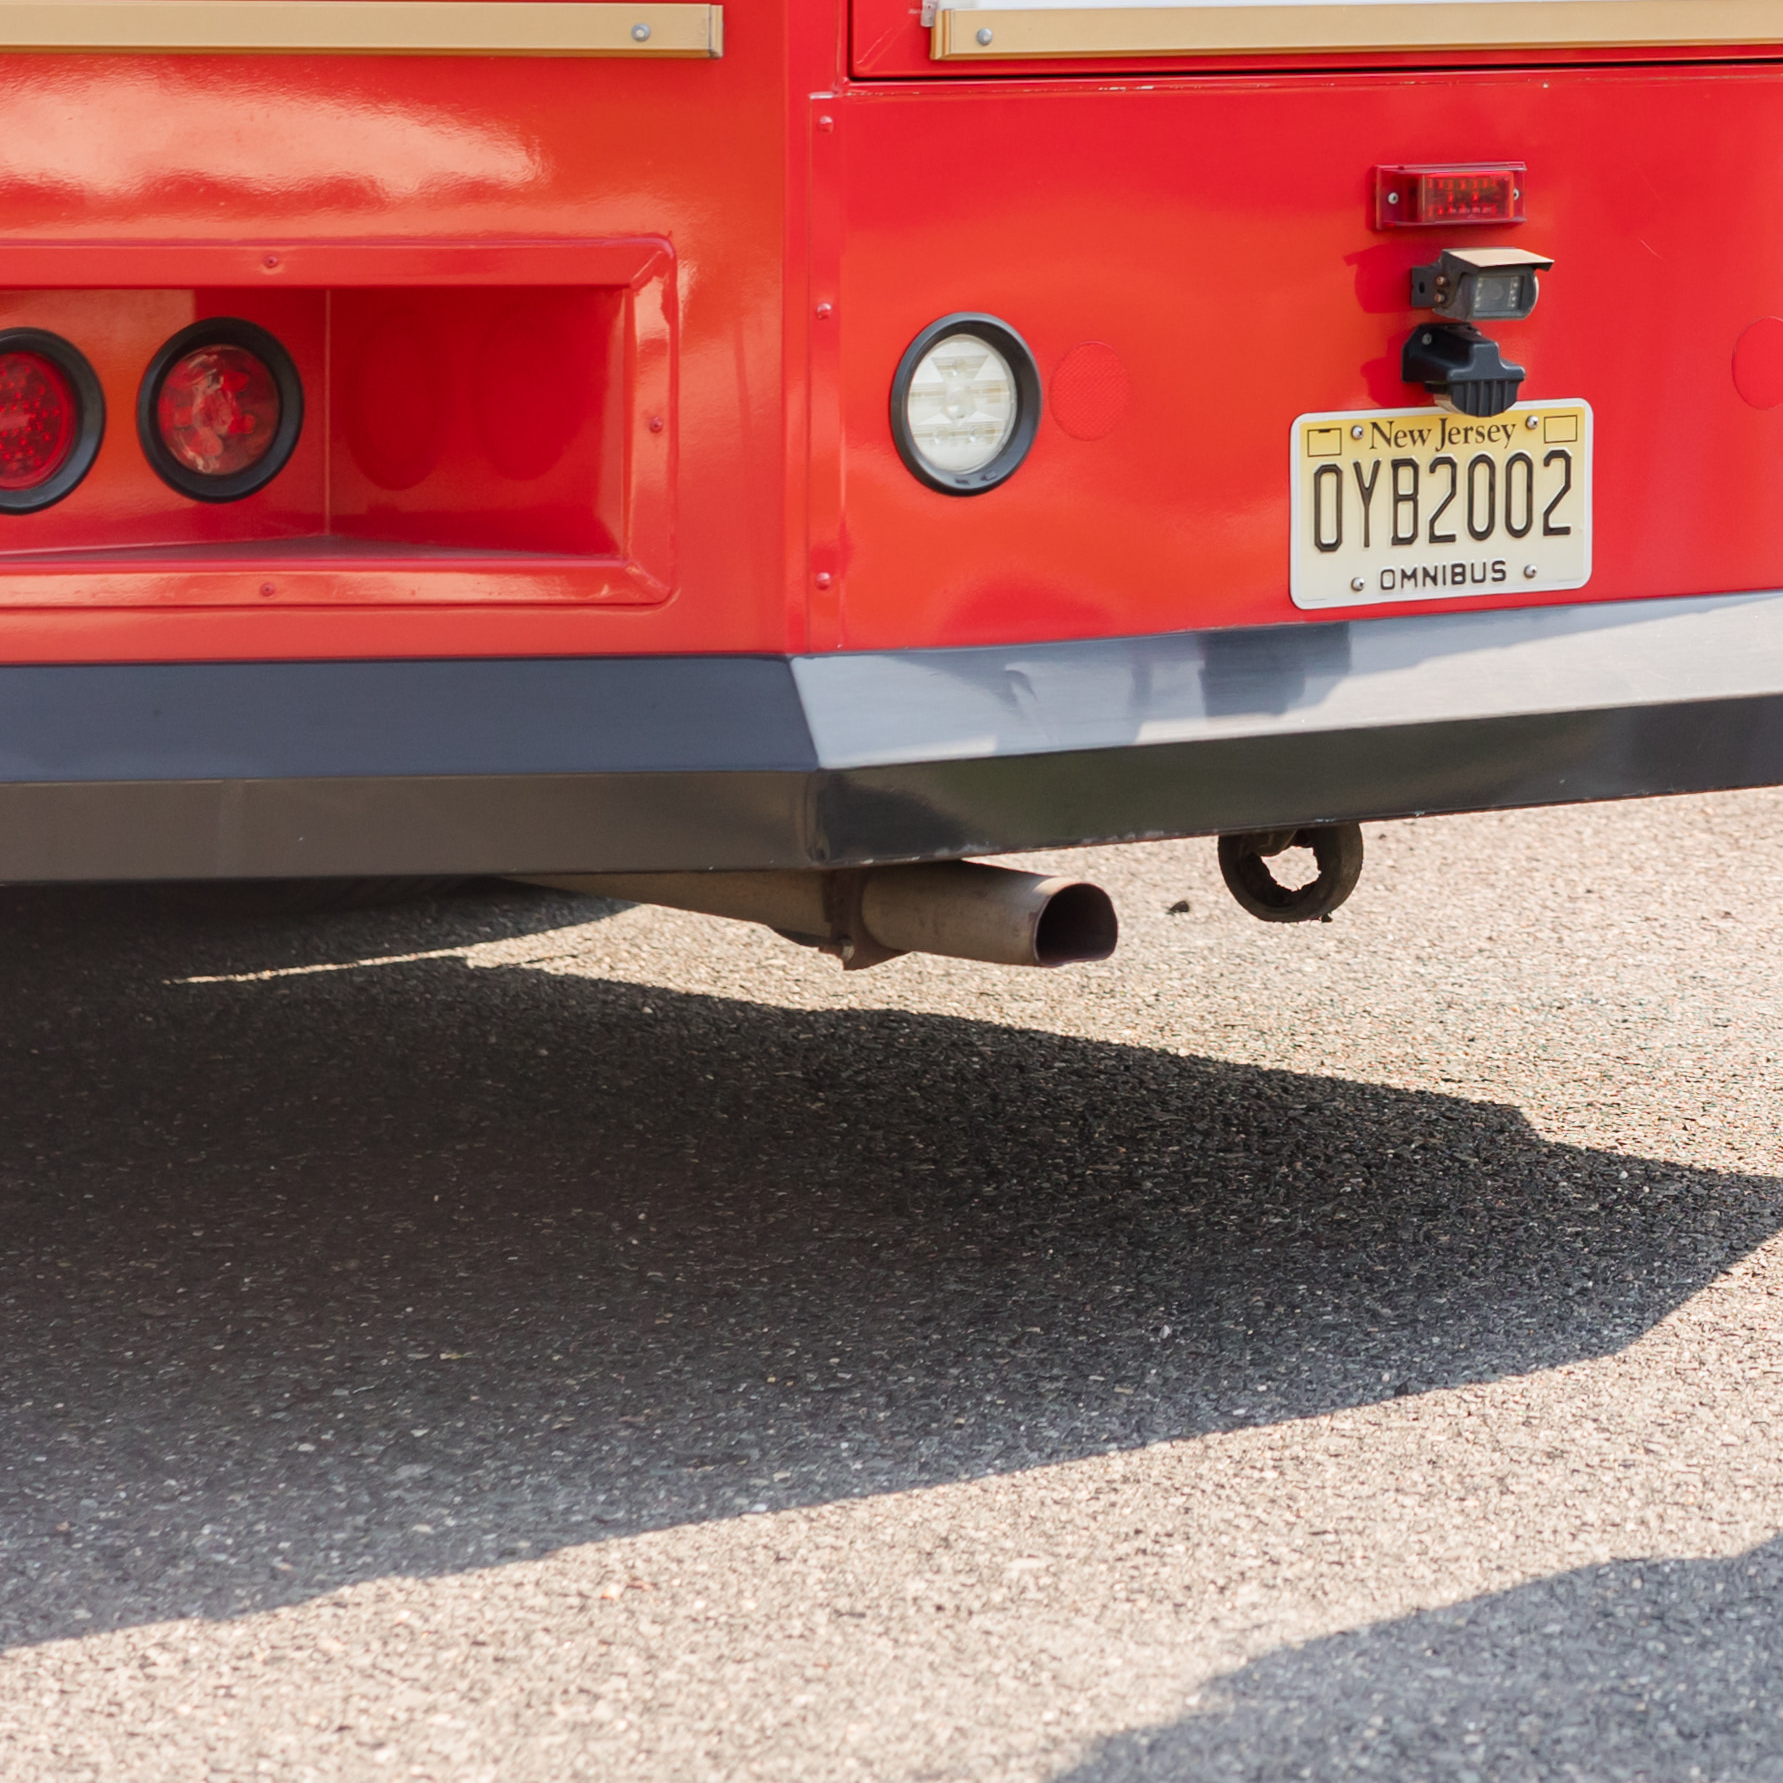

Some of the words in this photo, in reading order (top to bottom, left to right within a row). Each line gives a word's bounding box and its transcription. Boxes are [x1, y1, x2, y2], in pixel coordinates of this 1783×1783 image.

[1369, 420, 1431, 449] New
[1435, 417, 1516, 451] Jersey
[1380, 560, 1507, 590] OMNIBUS
